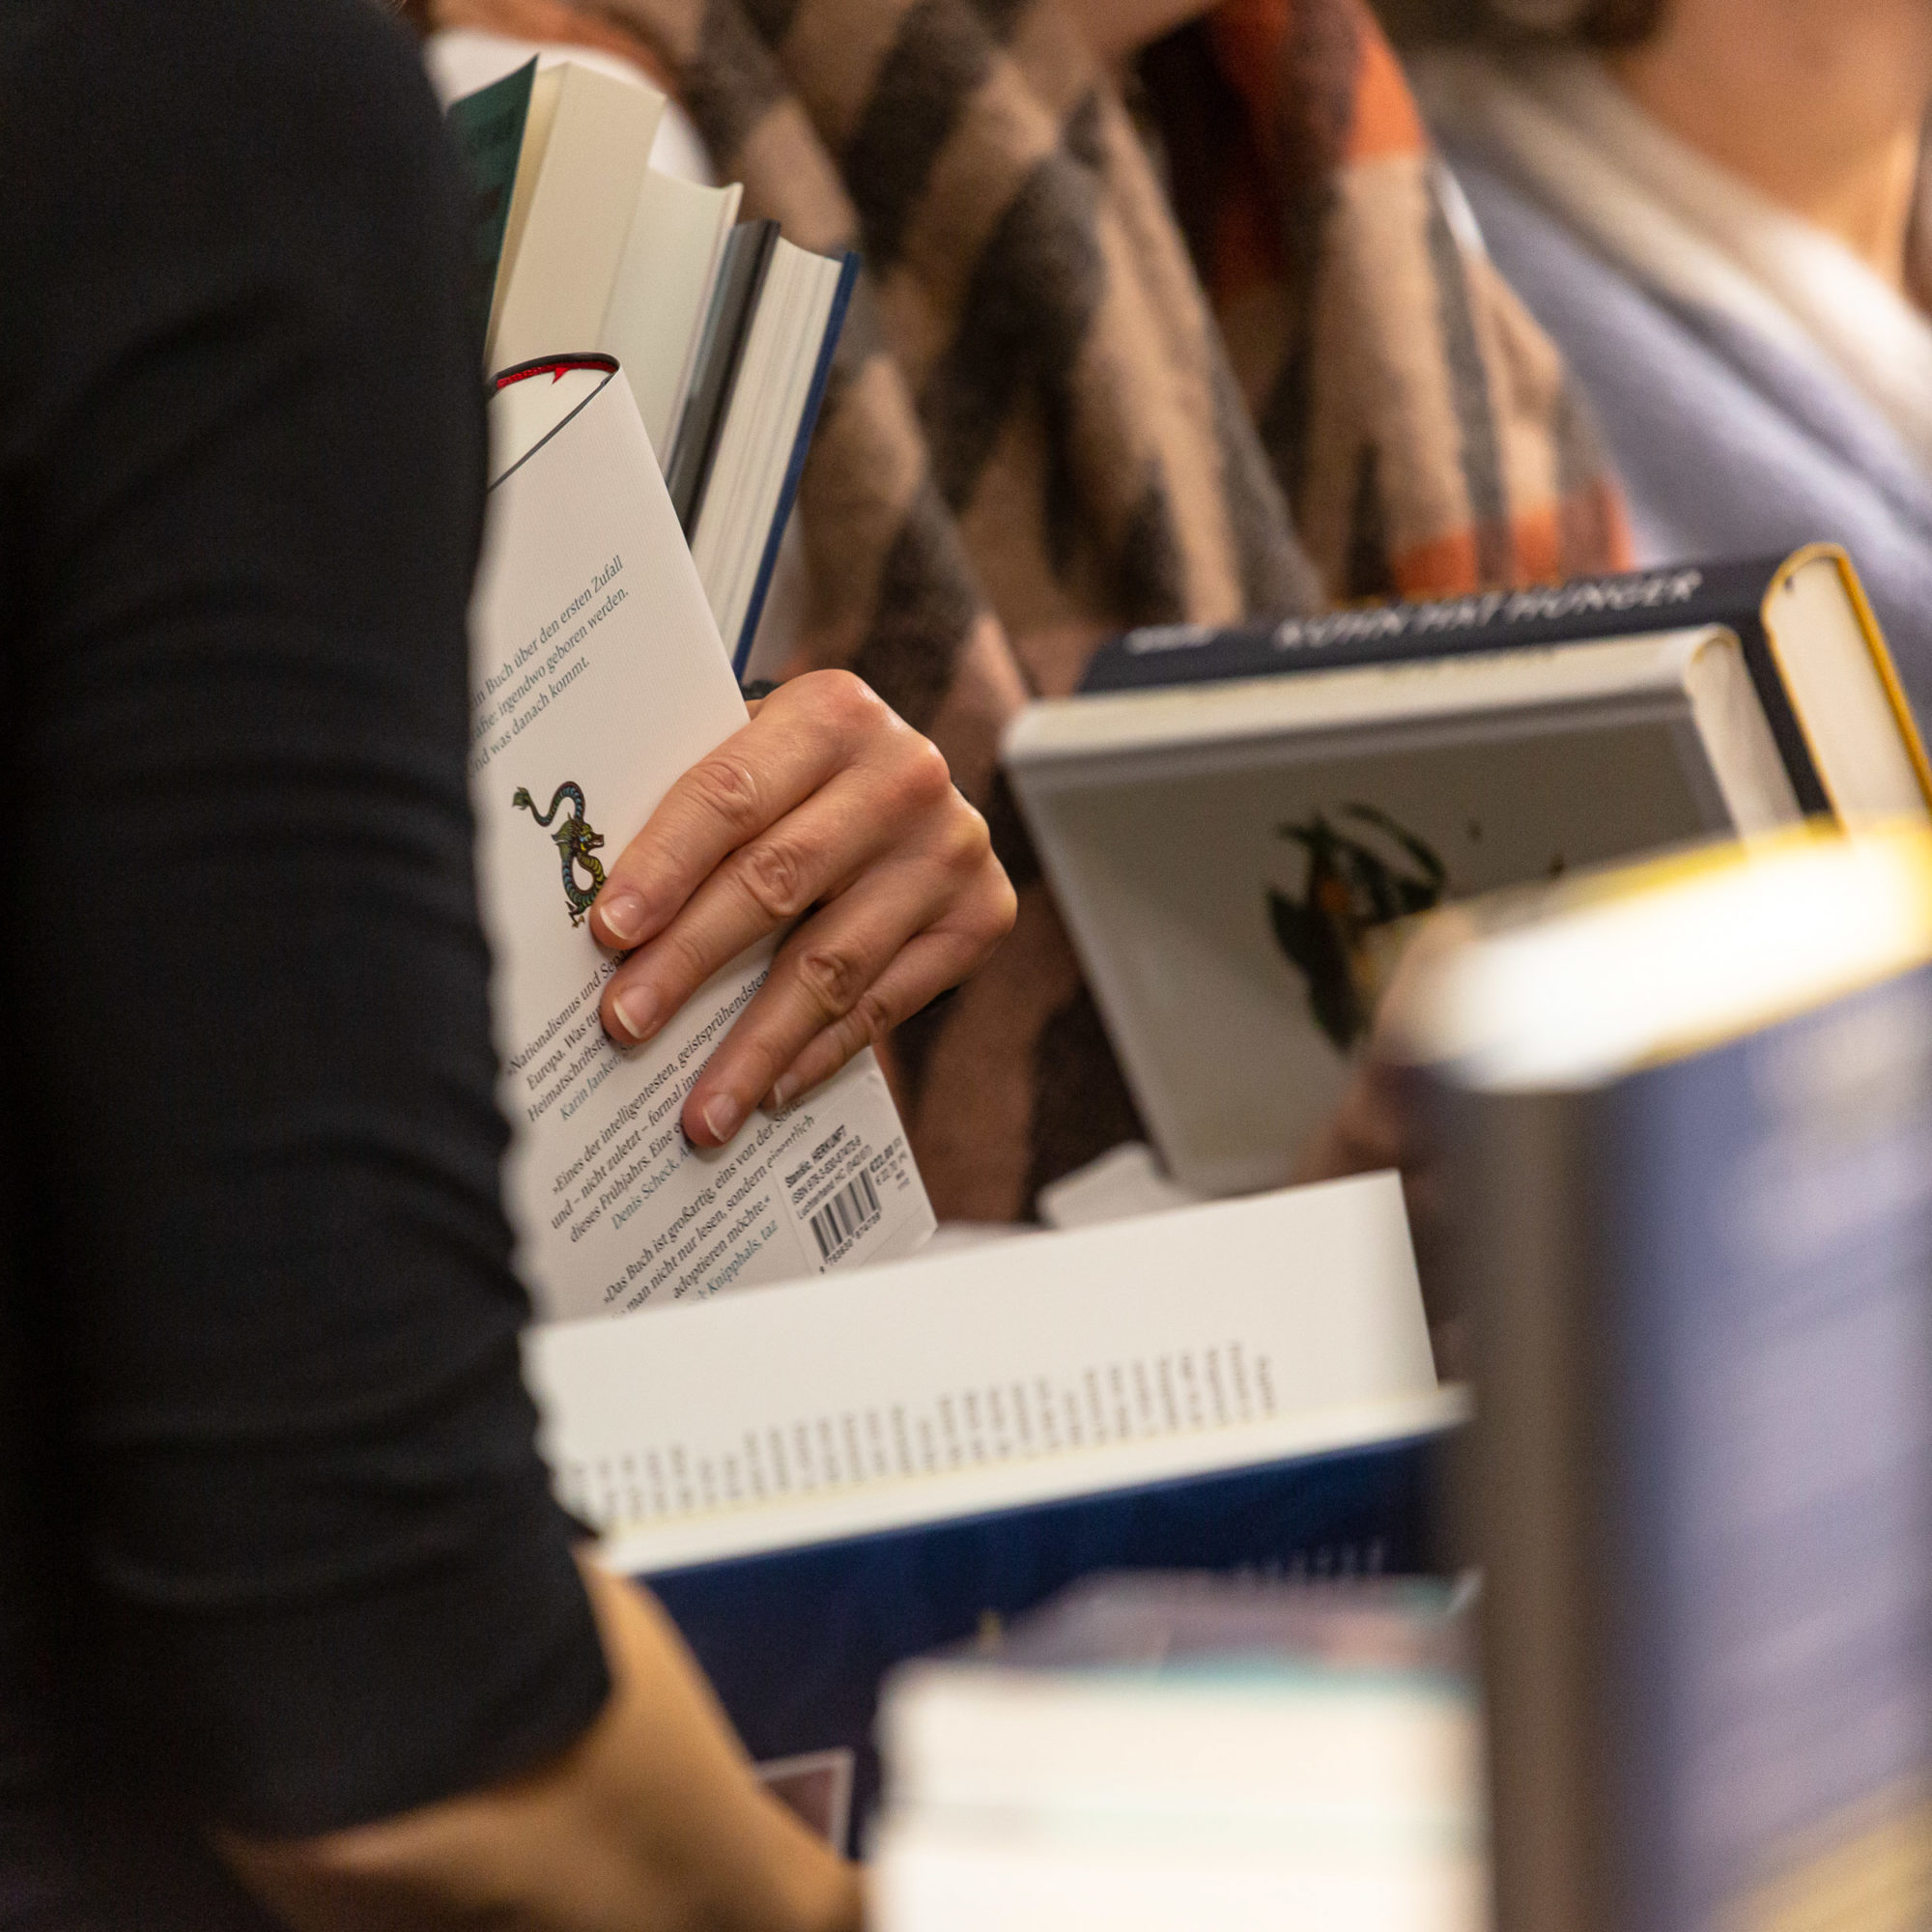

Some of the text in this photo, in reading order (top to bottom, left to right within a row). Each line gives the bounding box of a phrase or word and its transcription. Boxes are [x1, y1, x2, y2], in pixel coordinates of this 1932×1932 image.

[473, 554, 623, 708] in Buch über den ersten Zufall
[497, 665, 547, 717] irgendwo
[546, 625, 588, 674] geboren
[587, 588, 629, 629] werden.
[474, 656, 590, 771] nd was danach kommt.
[580, 970, 602, 1001] und
[526, 1049, 567, 1091] Europa.
[563, 1023, 587, 1049] Was
[526, 1035, 605, 1122] Heimatschriftste
[559, 1088, 589, 1122] Karin
[551, 1157, 585, 1195] »Eines
[583, 1138, 602, 1163] der
[599, 1063, 679, 1144] intelligentesten,
[551, 1198, 574, 1230] und
[580, 1165, 608, 1199] nicht
[606, 1129, 642, 1172] zuletzt
[647, 1083, 683, 1127] formal
[570, 1126, 676, 1243] dieses Frühjahrs. Eine
[611, 1194, 643, 1230] Denis
[625, 1247, 654, 1281] Buch
[651, 1234, 668, 1254] ist
[715, 1162, 737, 1189] eins
[734, 1143, 757, 1166] von
[755, 1122, 774, 1147] der
[626, 1285, 652, 1312] man
[649, 1255, 678, 1290] nicht
[679, 1236, 697, 1259] nur
[695, 1209, 727, 1241] lesen,
[725, 1165, 768, 1211] sondern
[759, 1219, 779, 1241] taz
[672, 1239, 728, 1299] adoptieren
